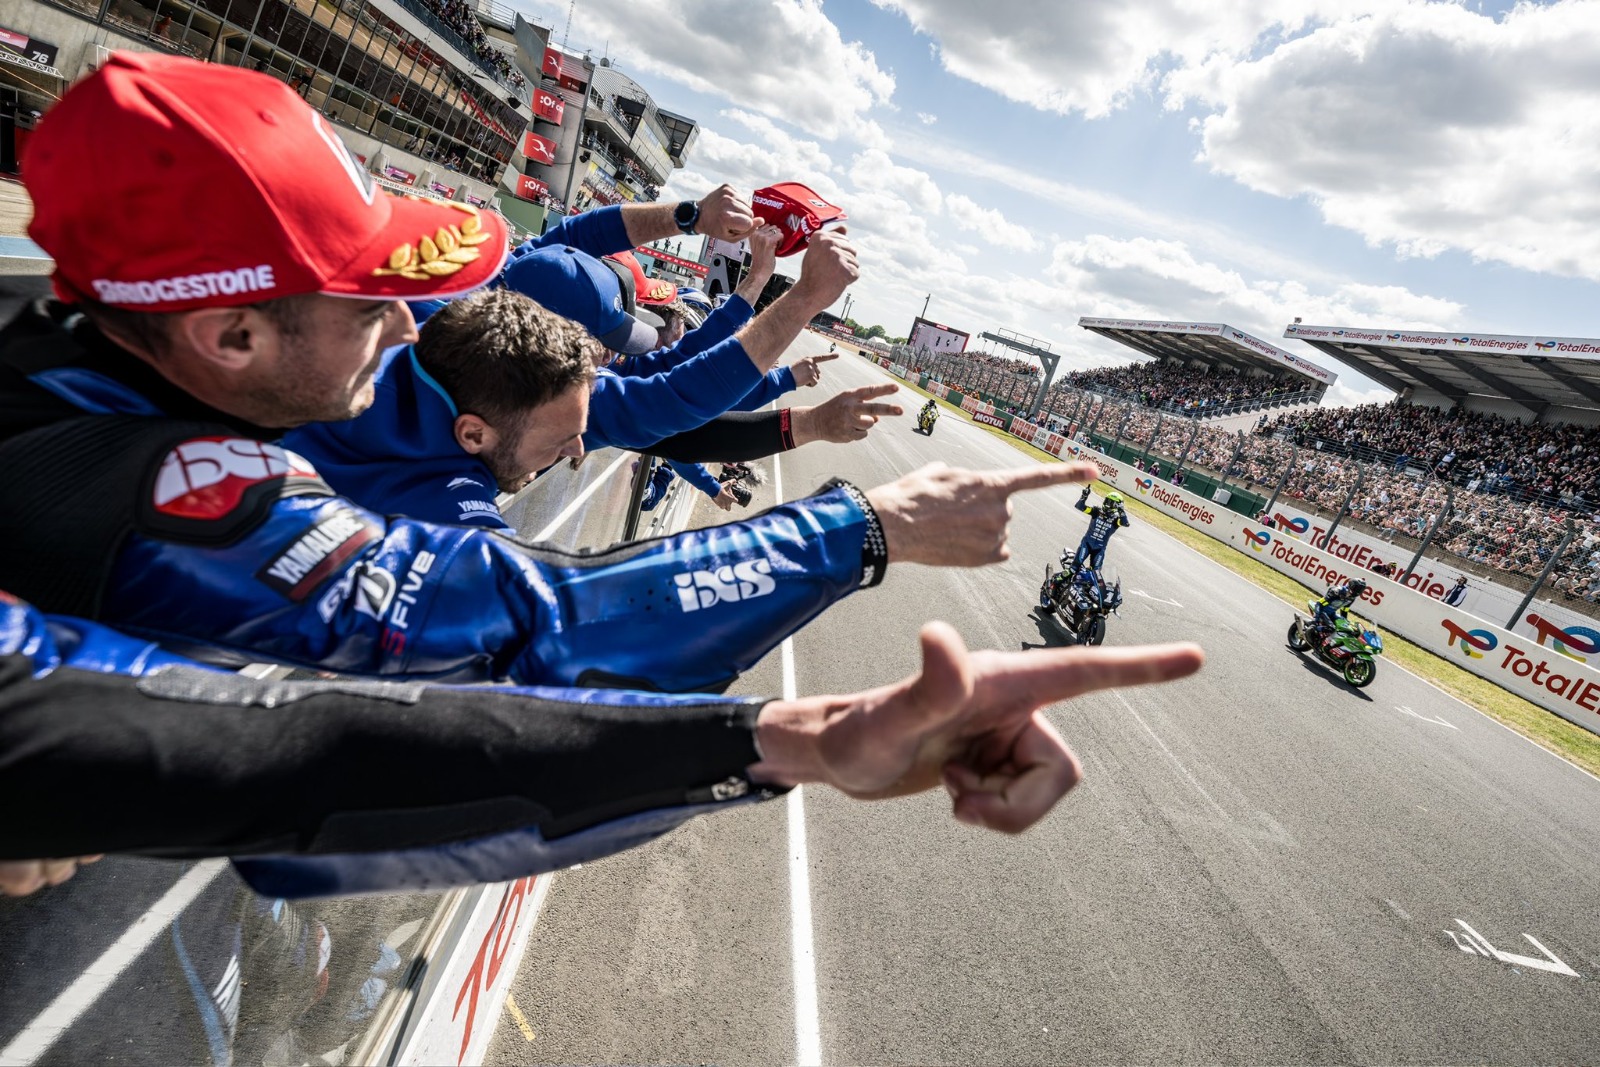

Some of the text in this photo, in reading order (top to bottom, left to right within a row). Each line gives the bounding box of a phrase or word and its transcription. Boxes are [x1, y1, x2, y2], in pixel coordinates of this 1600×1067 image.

[31, 50, 49, 64] 76
[91, 264, 276, 304] BRIDGESTONE
[1343, 331, 1383, 341] TotalEnergies
[1400, 334, 1448, 345] TotalEnergies
[1469, 338, 1528, 351] TotalEnergies
[973, 412, 1004, 428] MOTUL
[1150, 483, 1215, 525] TotalEnergies
[1270, 539, 1385, 606] TotalEneres
[1104, 592, 1114, 603] 1
[1501, 644, 1600, 716] TotalE
